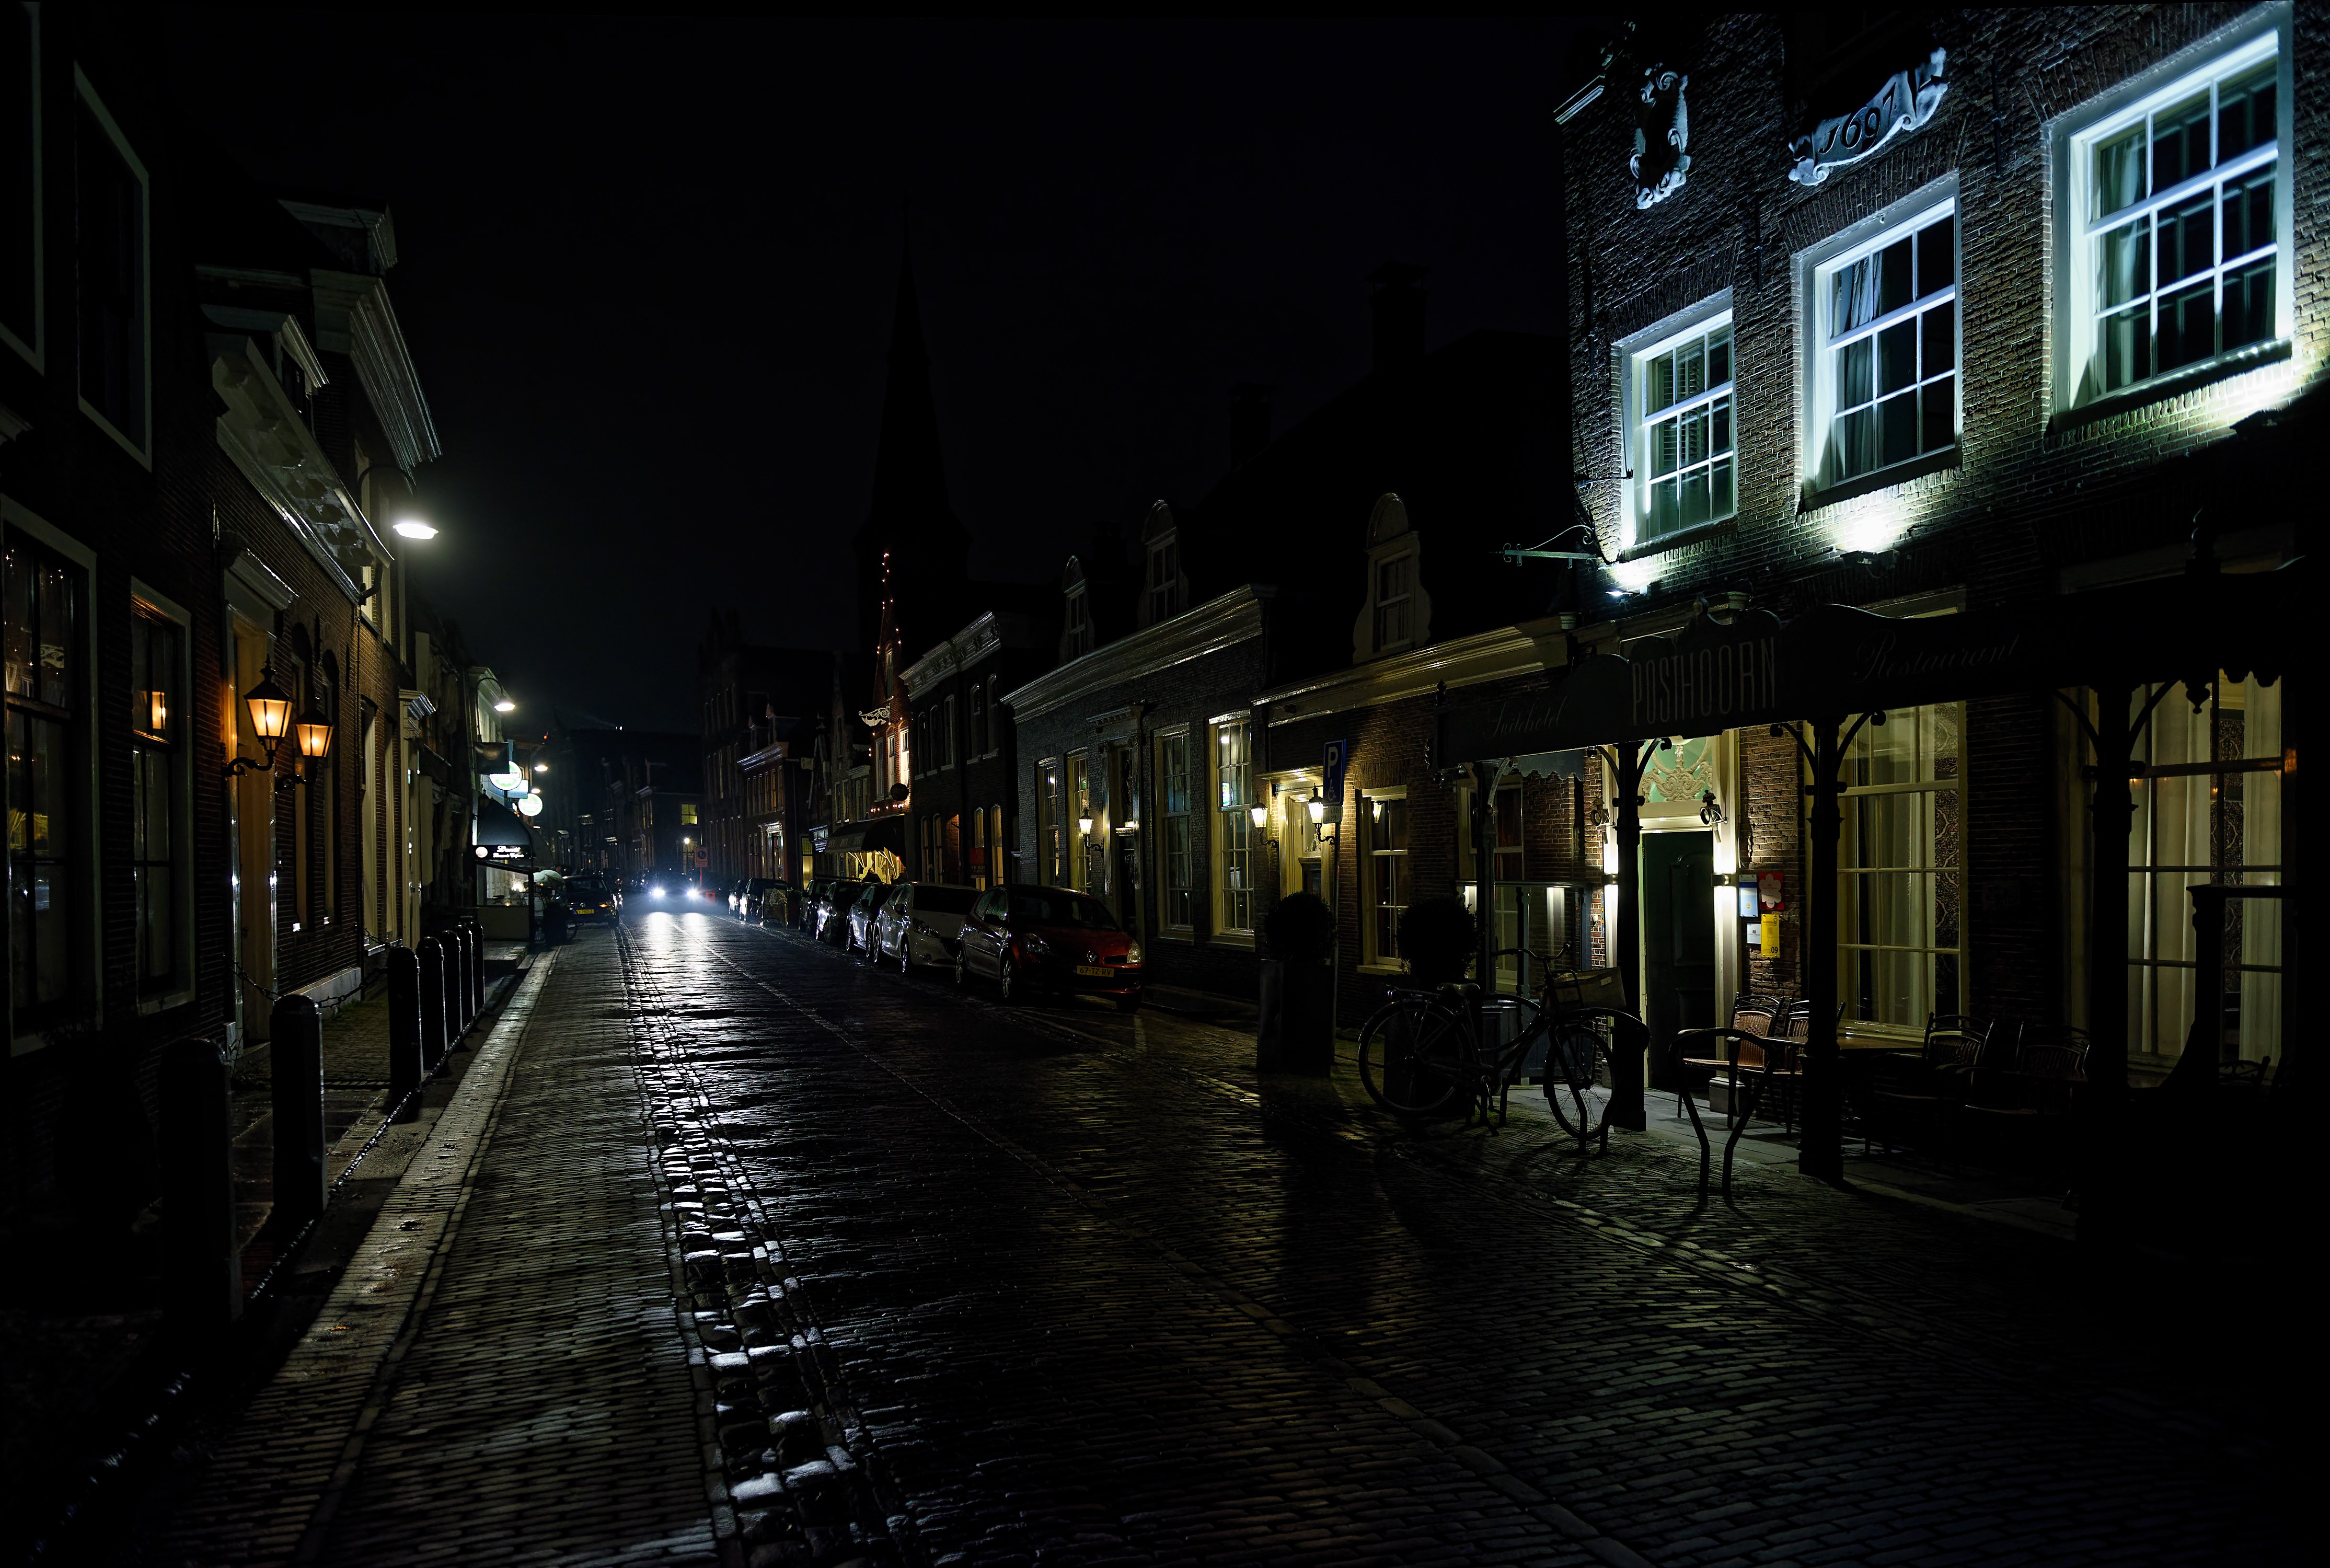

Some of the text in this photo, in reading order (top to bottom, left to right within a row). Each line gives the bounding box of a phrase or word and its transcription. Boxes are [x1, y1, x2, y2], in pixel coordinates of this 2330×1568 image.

[1818, 81, 1897, 157] 1697
[1632, 636, 1775, 727] POSTHOORN
[1853, 628, 2020, 683] Restaurant
[1327, 746, 1339, 778] P
[1080, 967, 1111, 976] 67-TZ-RV
